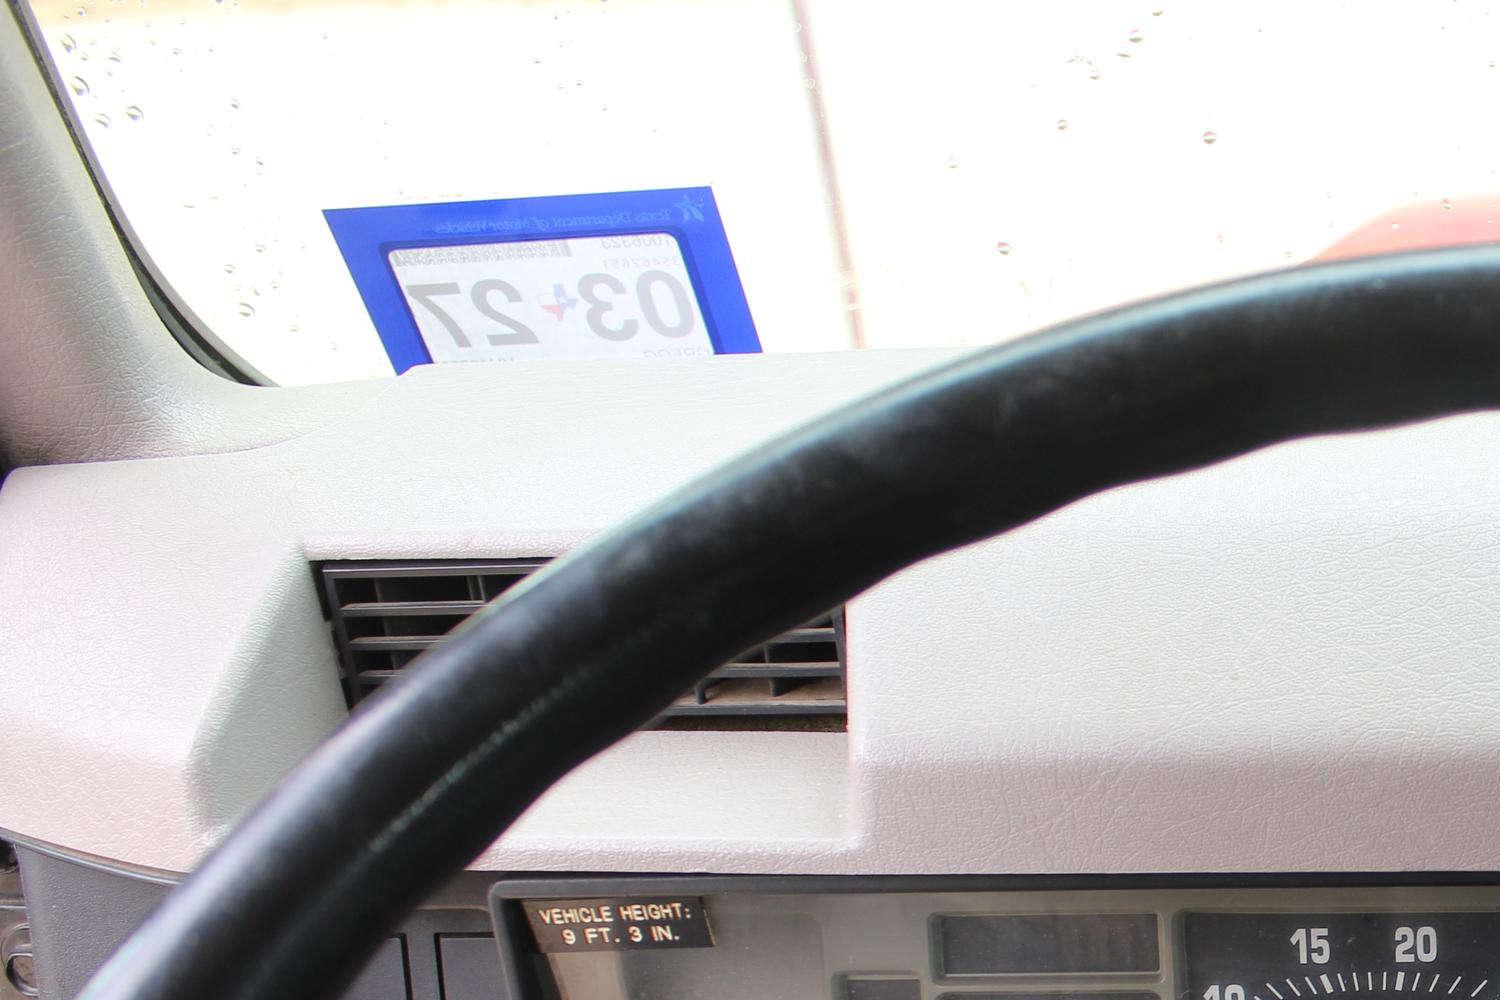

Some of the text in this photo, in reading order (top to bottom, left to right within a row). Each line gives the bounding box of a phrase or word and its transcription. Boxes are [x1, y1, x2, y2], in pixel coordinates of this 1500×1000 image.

[539, 902, 692, 925] VEHICLE HEIGHT:
[562, 924, 680, 945] 9 FT. 3 IN.
[1290, 928, 1331, 964] 15
[1394, 926, 1437, 963] 20
